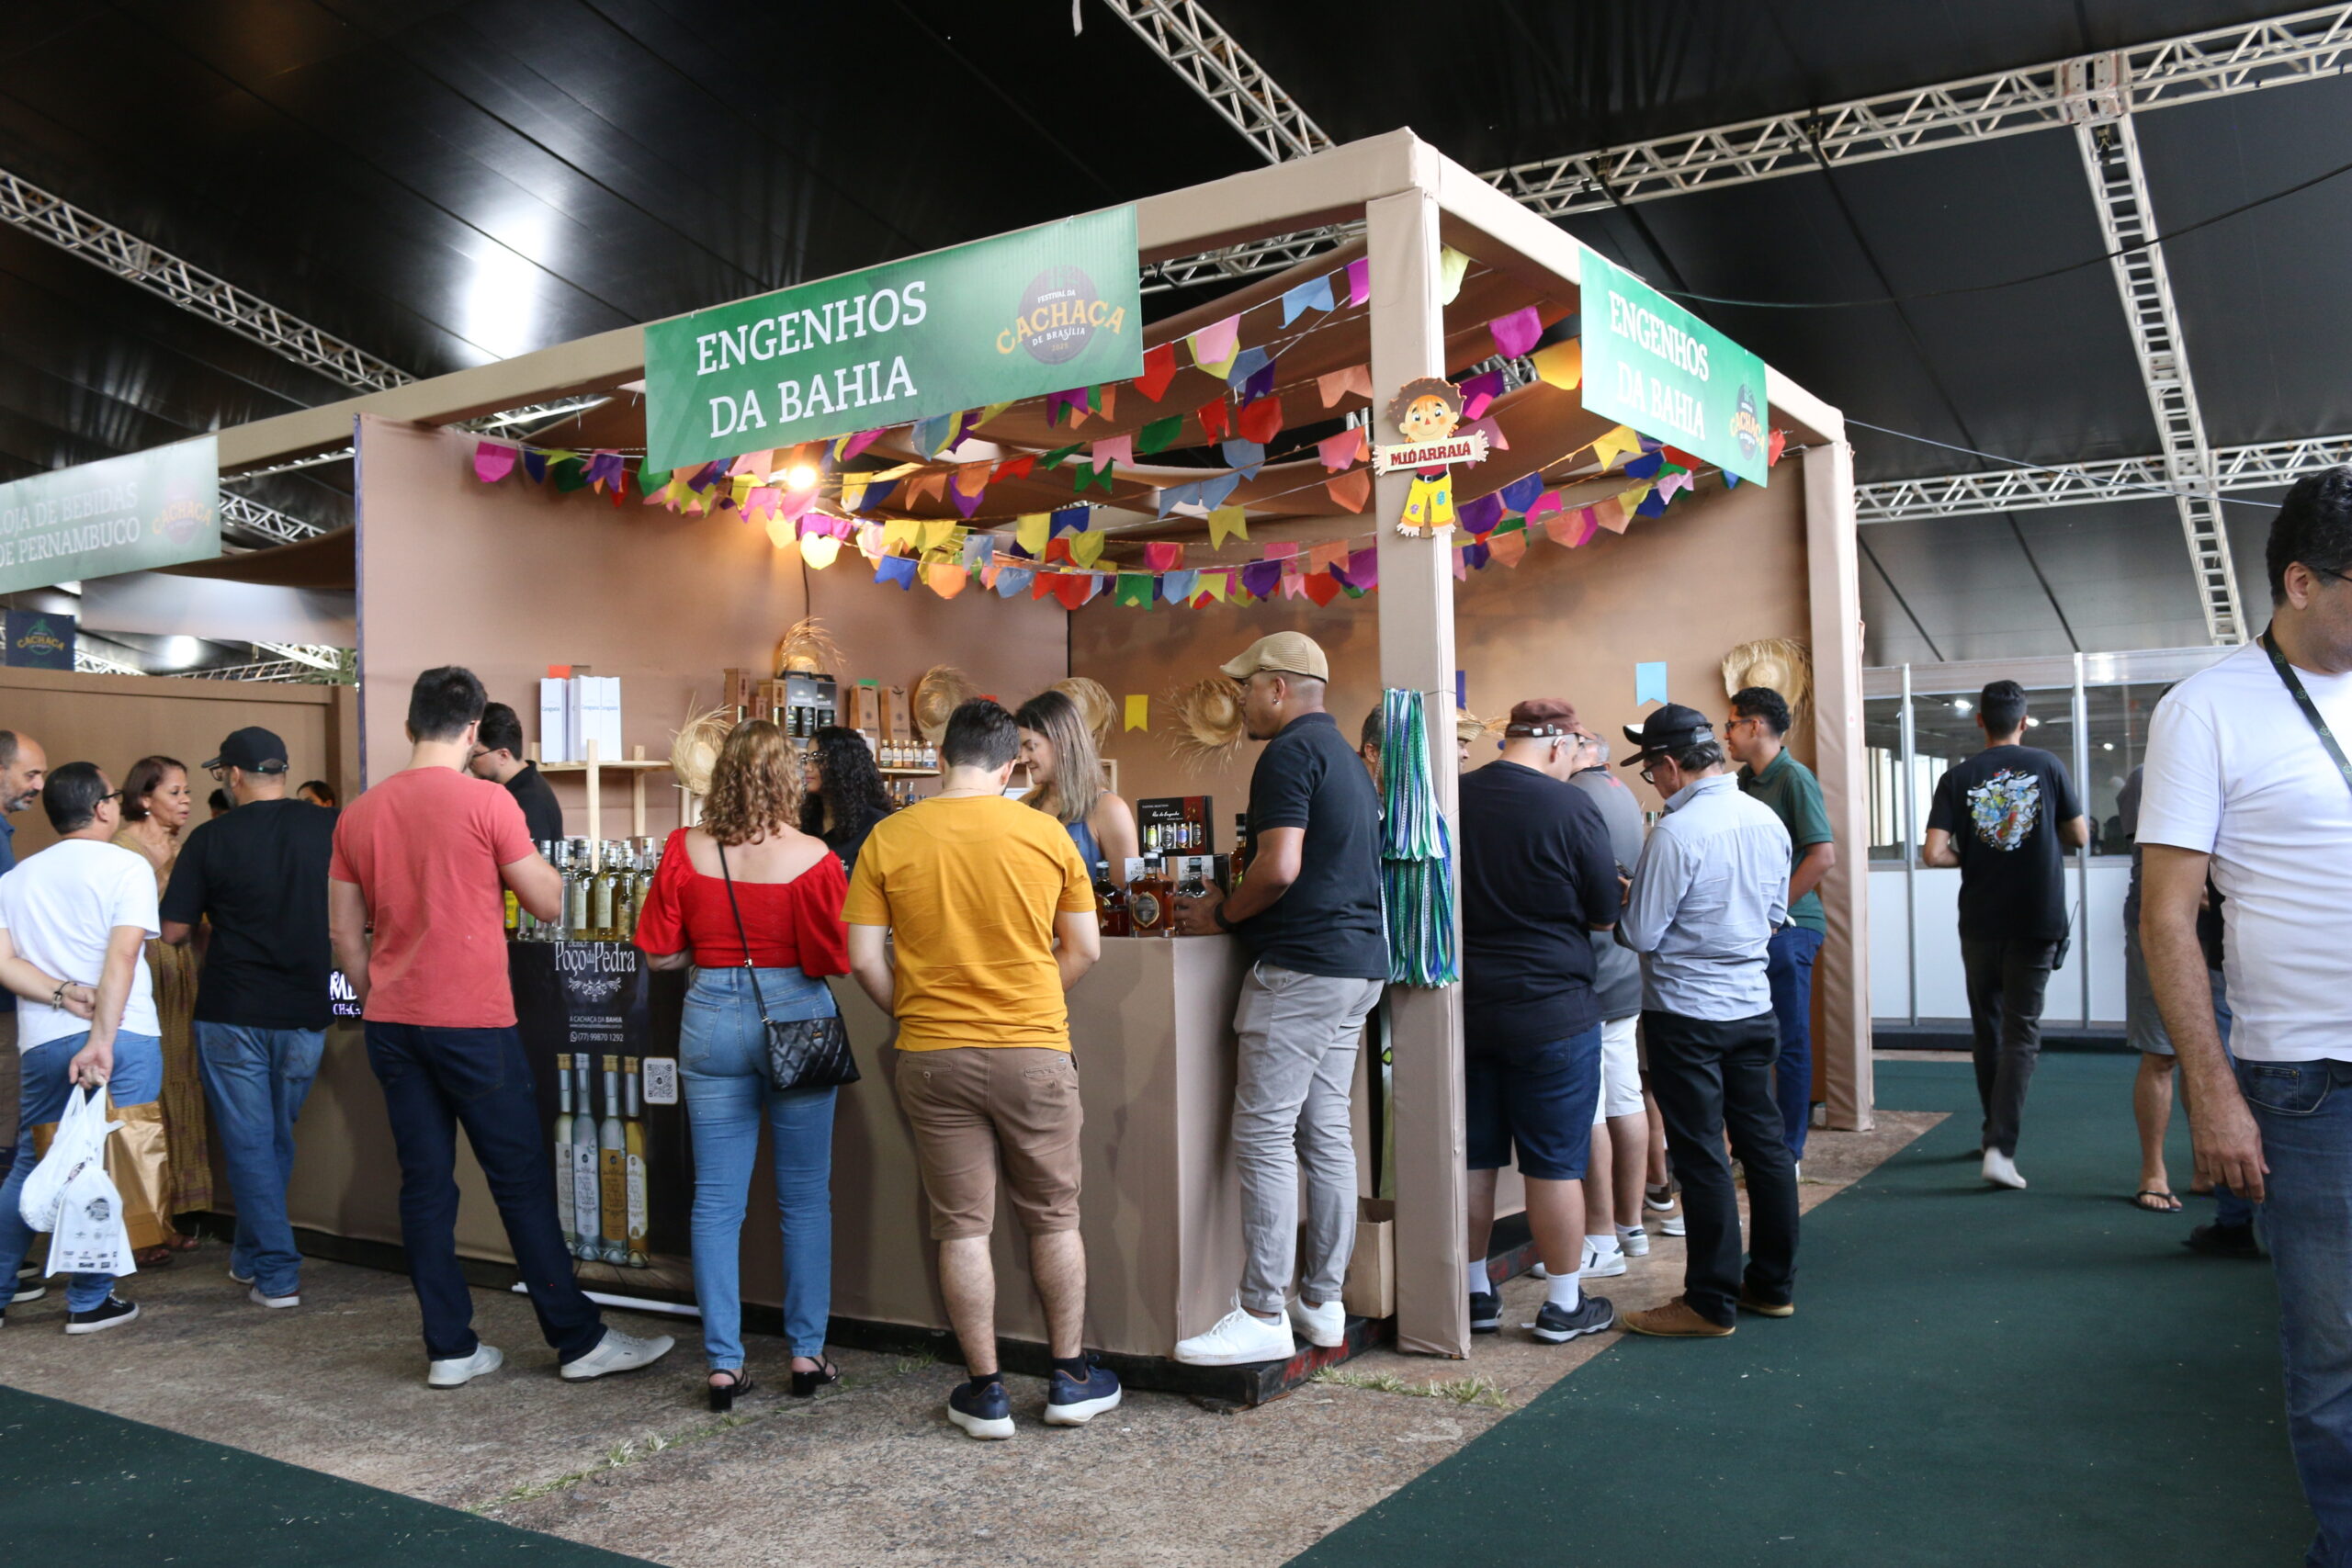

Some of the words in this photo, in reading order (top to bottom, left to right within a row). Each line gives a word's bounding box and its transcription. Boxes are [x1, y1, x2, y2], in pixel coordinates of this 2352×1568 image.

[1037, 291, 1066, 303] FESTIVAL
[695, 280, 927, 376] ENGENHOS
[996, 299, 1125, 355] CACHAÇA
[1032, 335, 1044, 346] DE
[1046, 326, 1085, 341] BRASÍLIA
[1609, 290, 1709, 381] ENGENHOS
[709, 389, 766, 438] DA
[778, 355, 917, 423] BAHIA
[1617, 361, 1645, 412] DA
[1651, 378, 1705, 441] BAHIA
[0, 506, 30, 536] OJA
[35, 500, 57, 527] DE
[62, 481, 137, 522] BEBIDAS
[18, 516, 141, 564] PERNAMBUCO
[555, 942, 586, 976] Poço
[594, 942, 637, 973] Pedra
